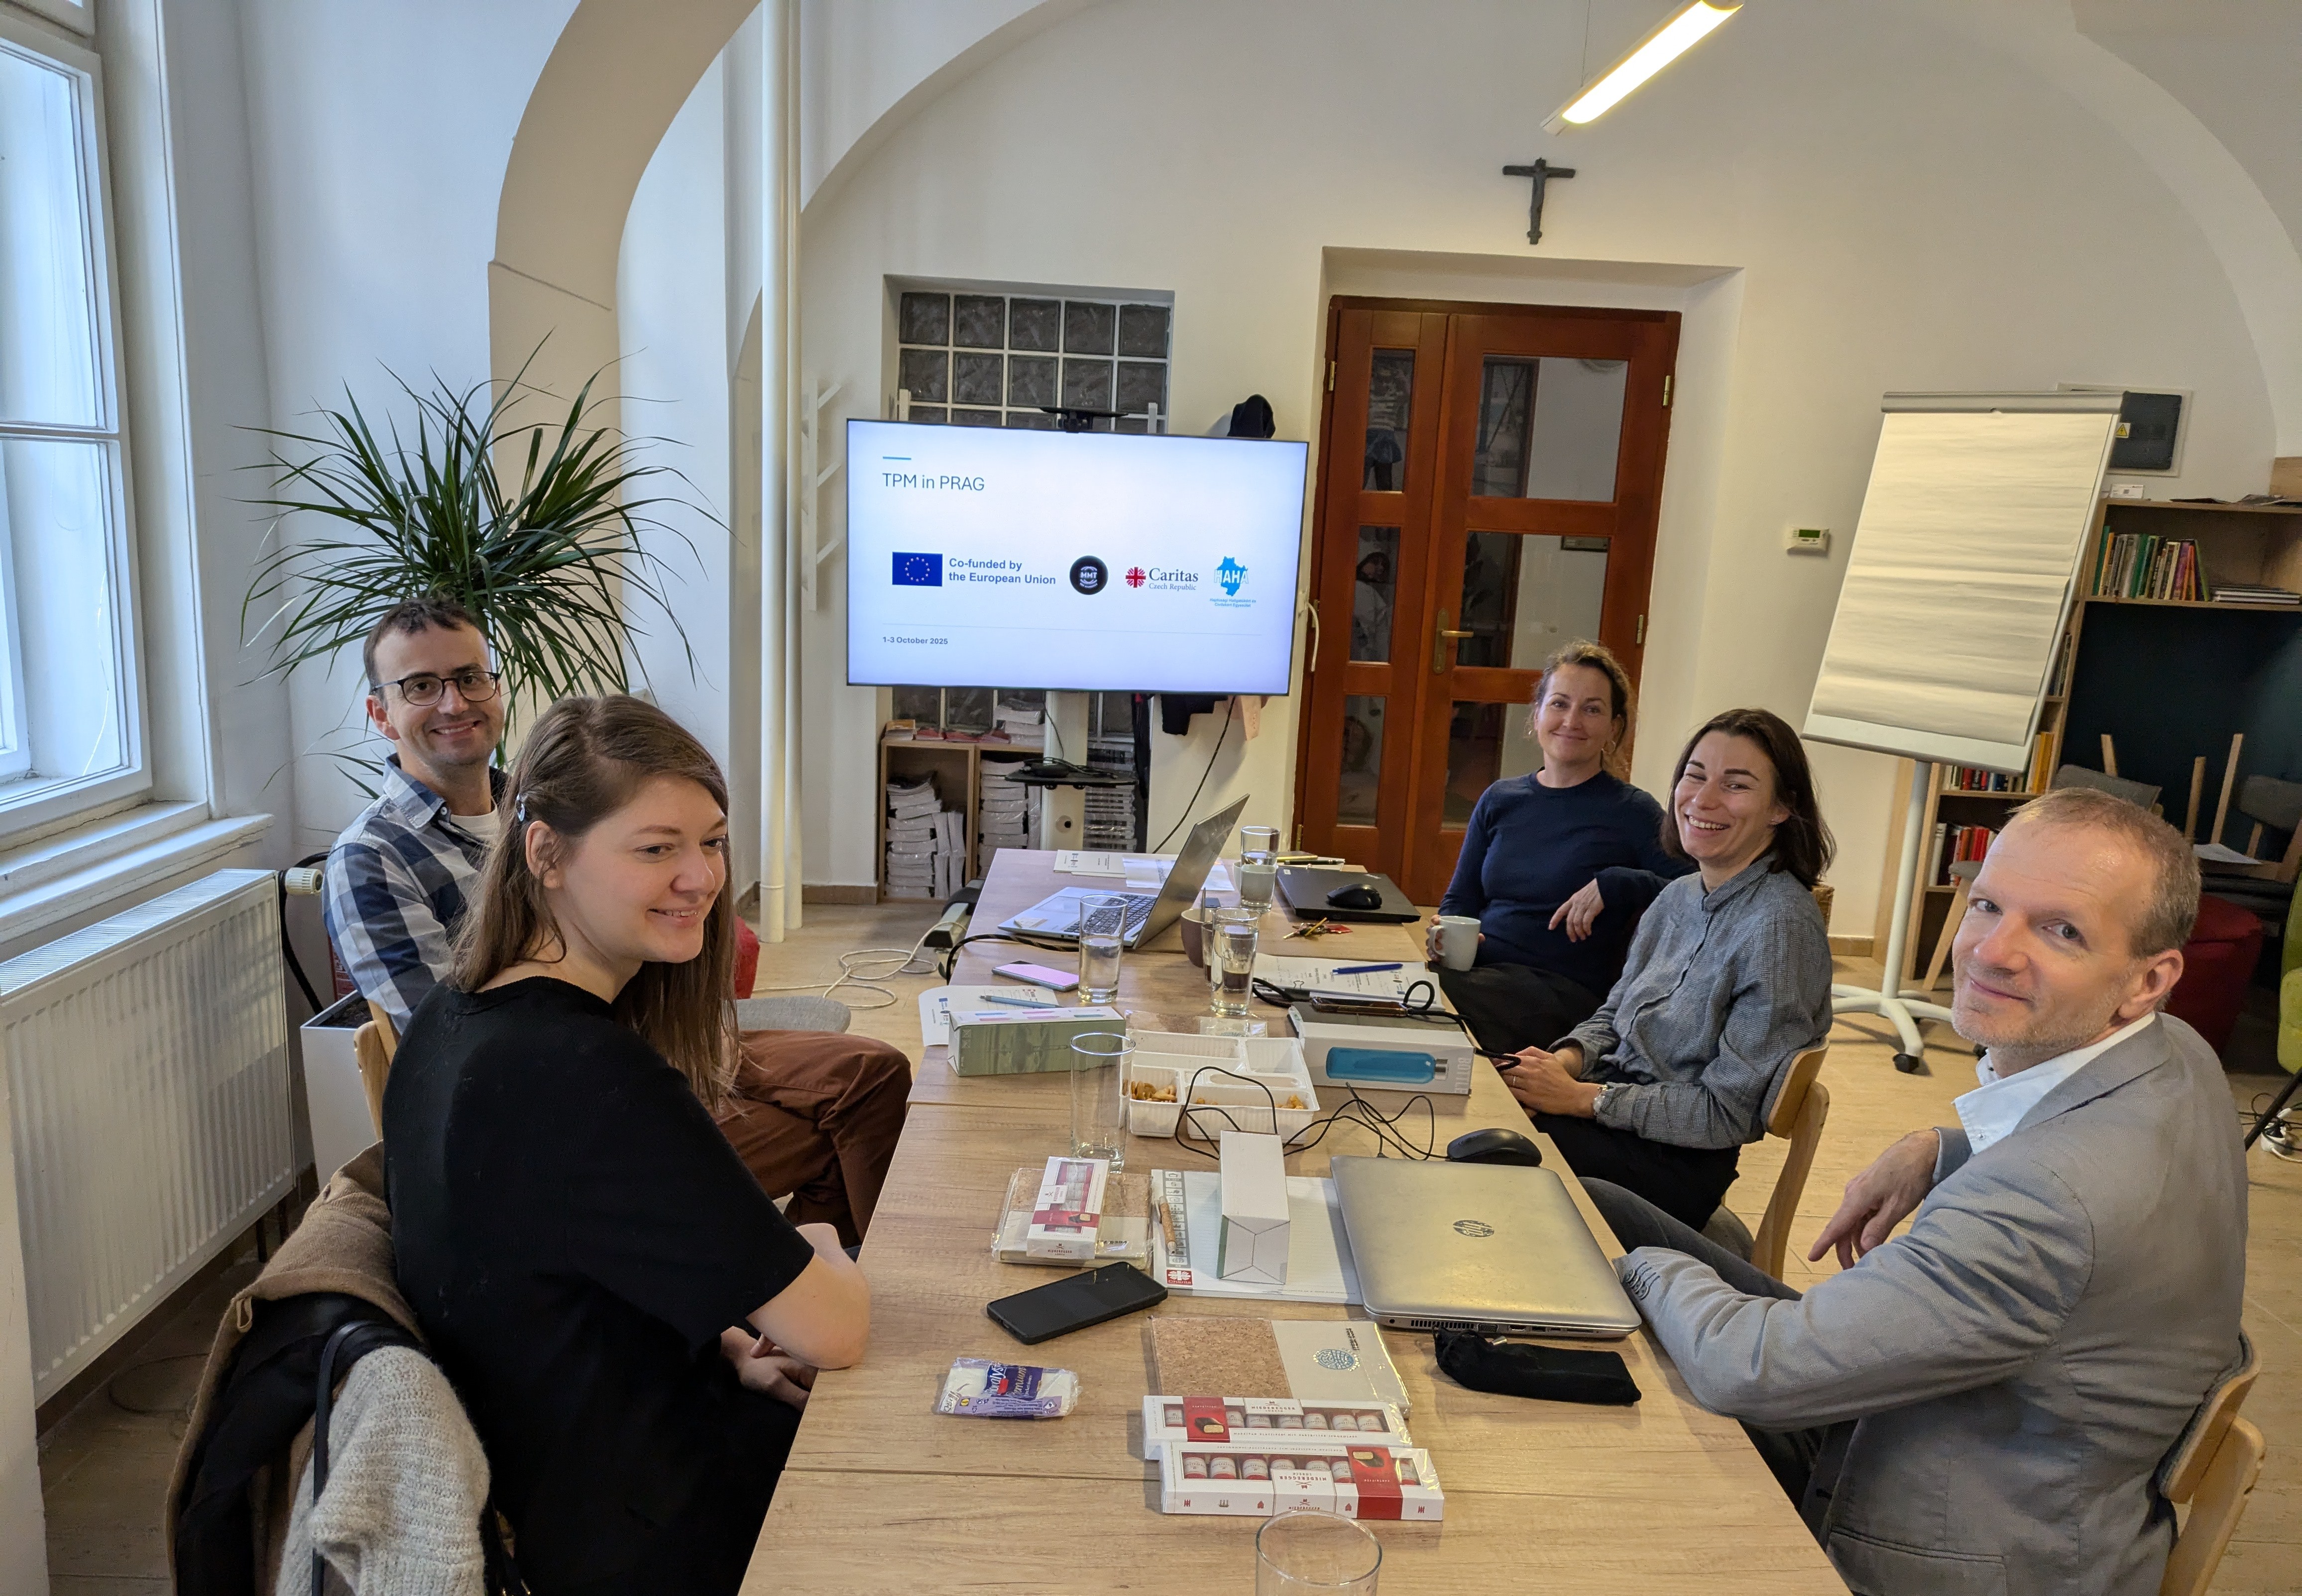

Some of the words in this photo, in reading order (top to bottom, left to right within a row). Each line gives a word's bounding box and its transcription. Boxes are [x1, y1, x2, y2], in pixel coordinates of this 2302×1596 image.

[882, 473, 917, 488] TPM
[922, 474, 934, 489] in
[940, 475, 985, 491] PRAG
[949, 558, 1006, 569] Co-funded
[1009, 560, 1022, 571] by
[949, 572, 966, 581] the
[969, 572, 1021, 584] European
[1025, 574, 1056, 584] Union
[1149, 568, 1199, 582] Caritas
[1214, 569, 1249, 584] HAHA
